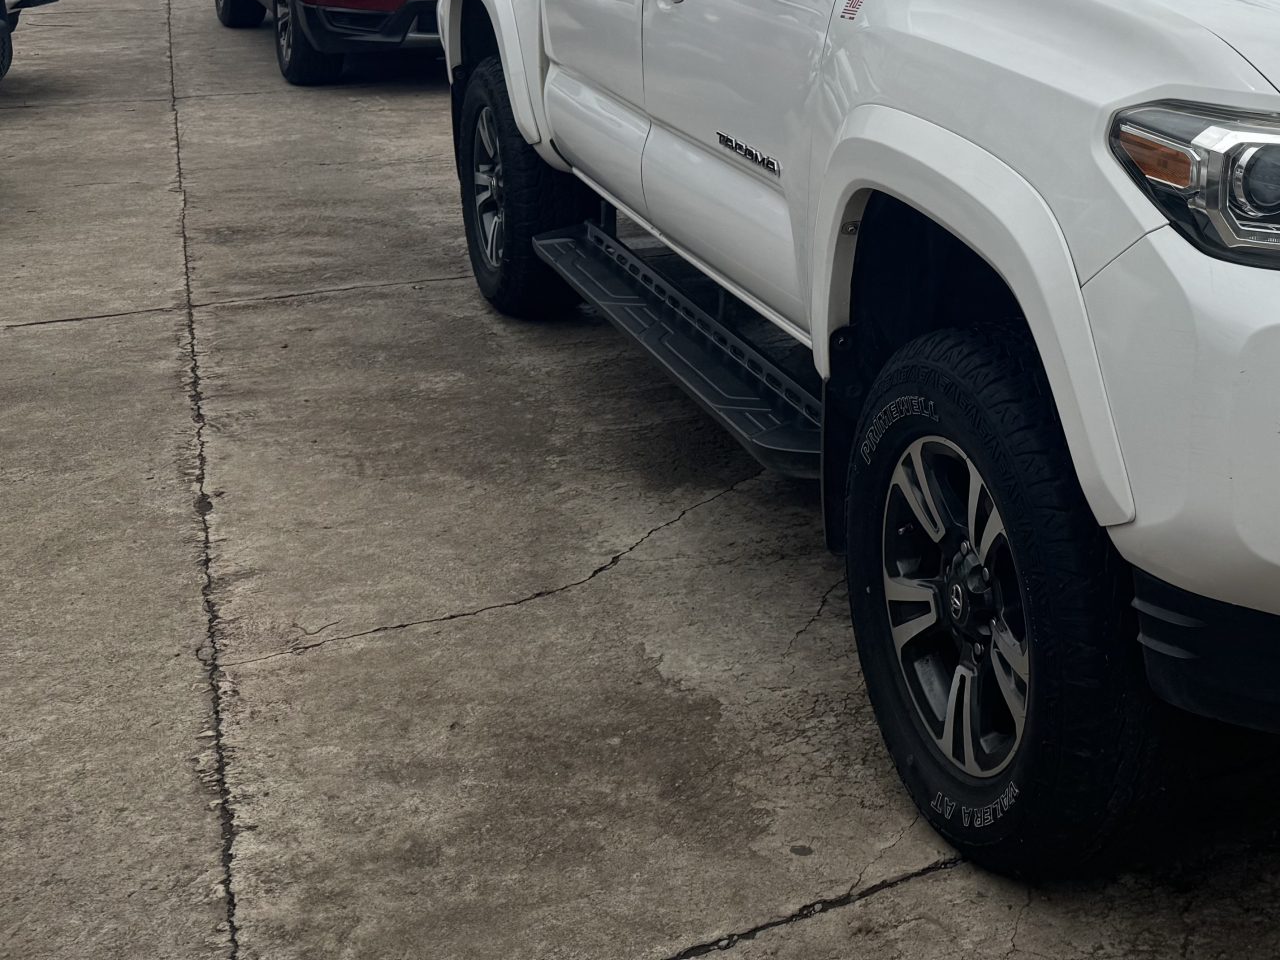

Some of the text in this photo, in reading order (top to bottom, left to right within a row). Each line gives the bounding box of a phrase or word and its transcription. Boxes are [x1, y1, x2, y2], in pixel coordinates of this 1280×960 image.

[716, 131, 781, 178] TACOMA
[860, 395, 940, 465] PRIMEWELL
[930, 780, 1020, 828] VALERA AT
